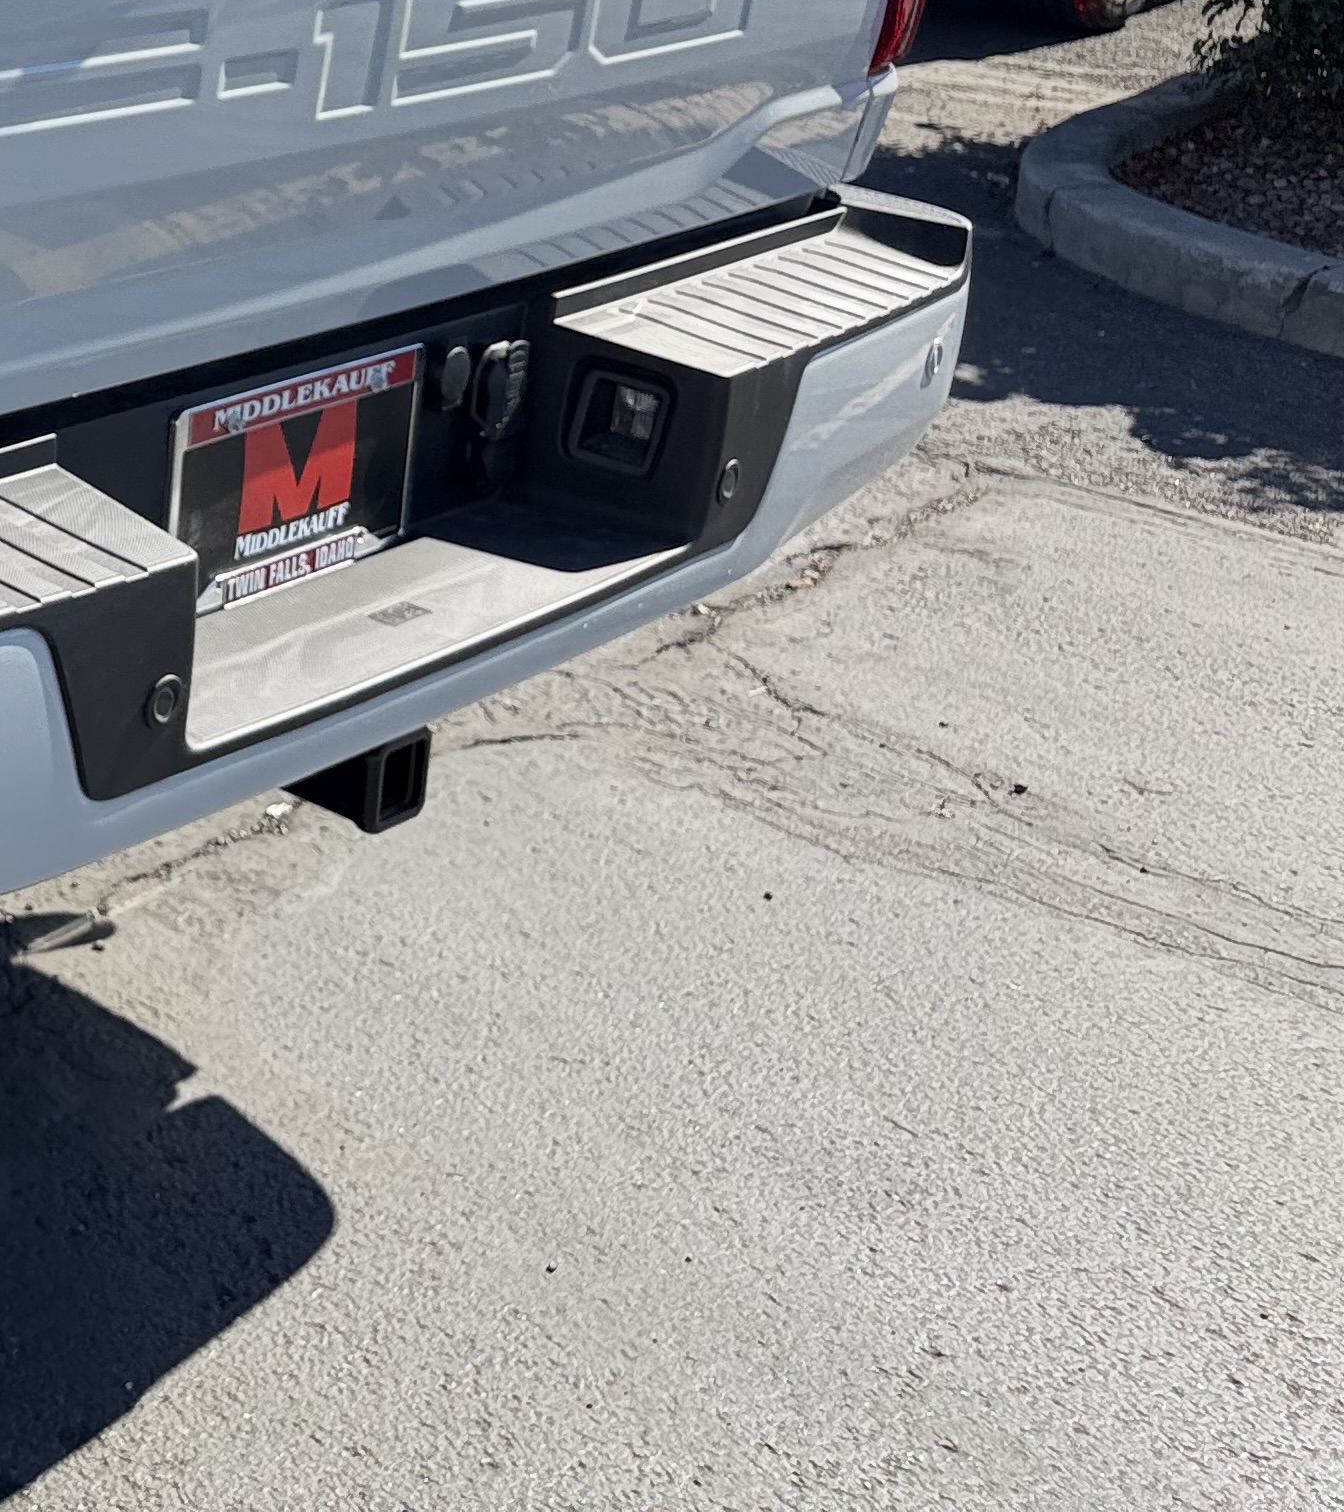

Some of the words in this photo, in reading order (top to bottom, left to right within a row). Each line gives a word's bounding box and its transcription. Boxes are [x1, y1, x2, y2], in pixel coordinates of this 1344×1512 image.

[213, 360, 396, 432] MIDDLEKAUFF
[233, 501, 352, 561] MIDDLEKAUFF
[226, 566, 268, 601] TWIN
[268, 551, 312, 587] FALLS,
[314, 536, 356, 570] IDAHO
